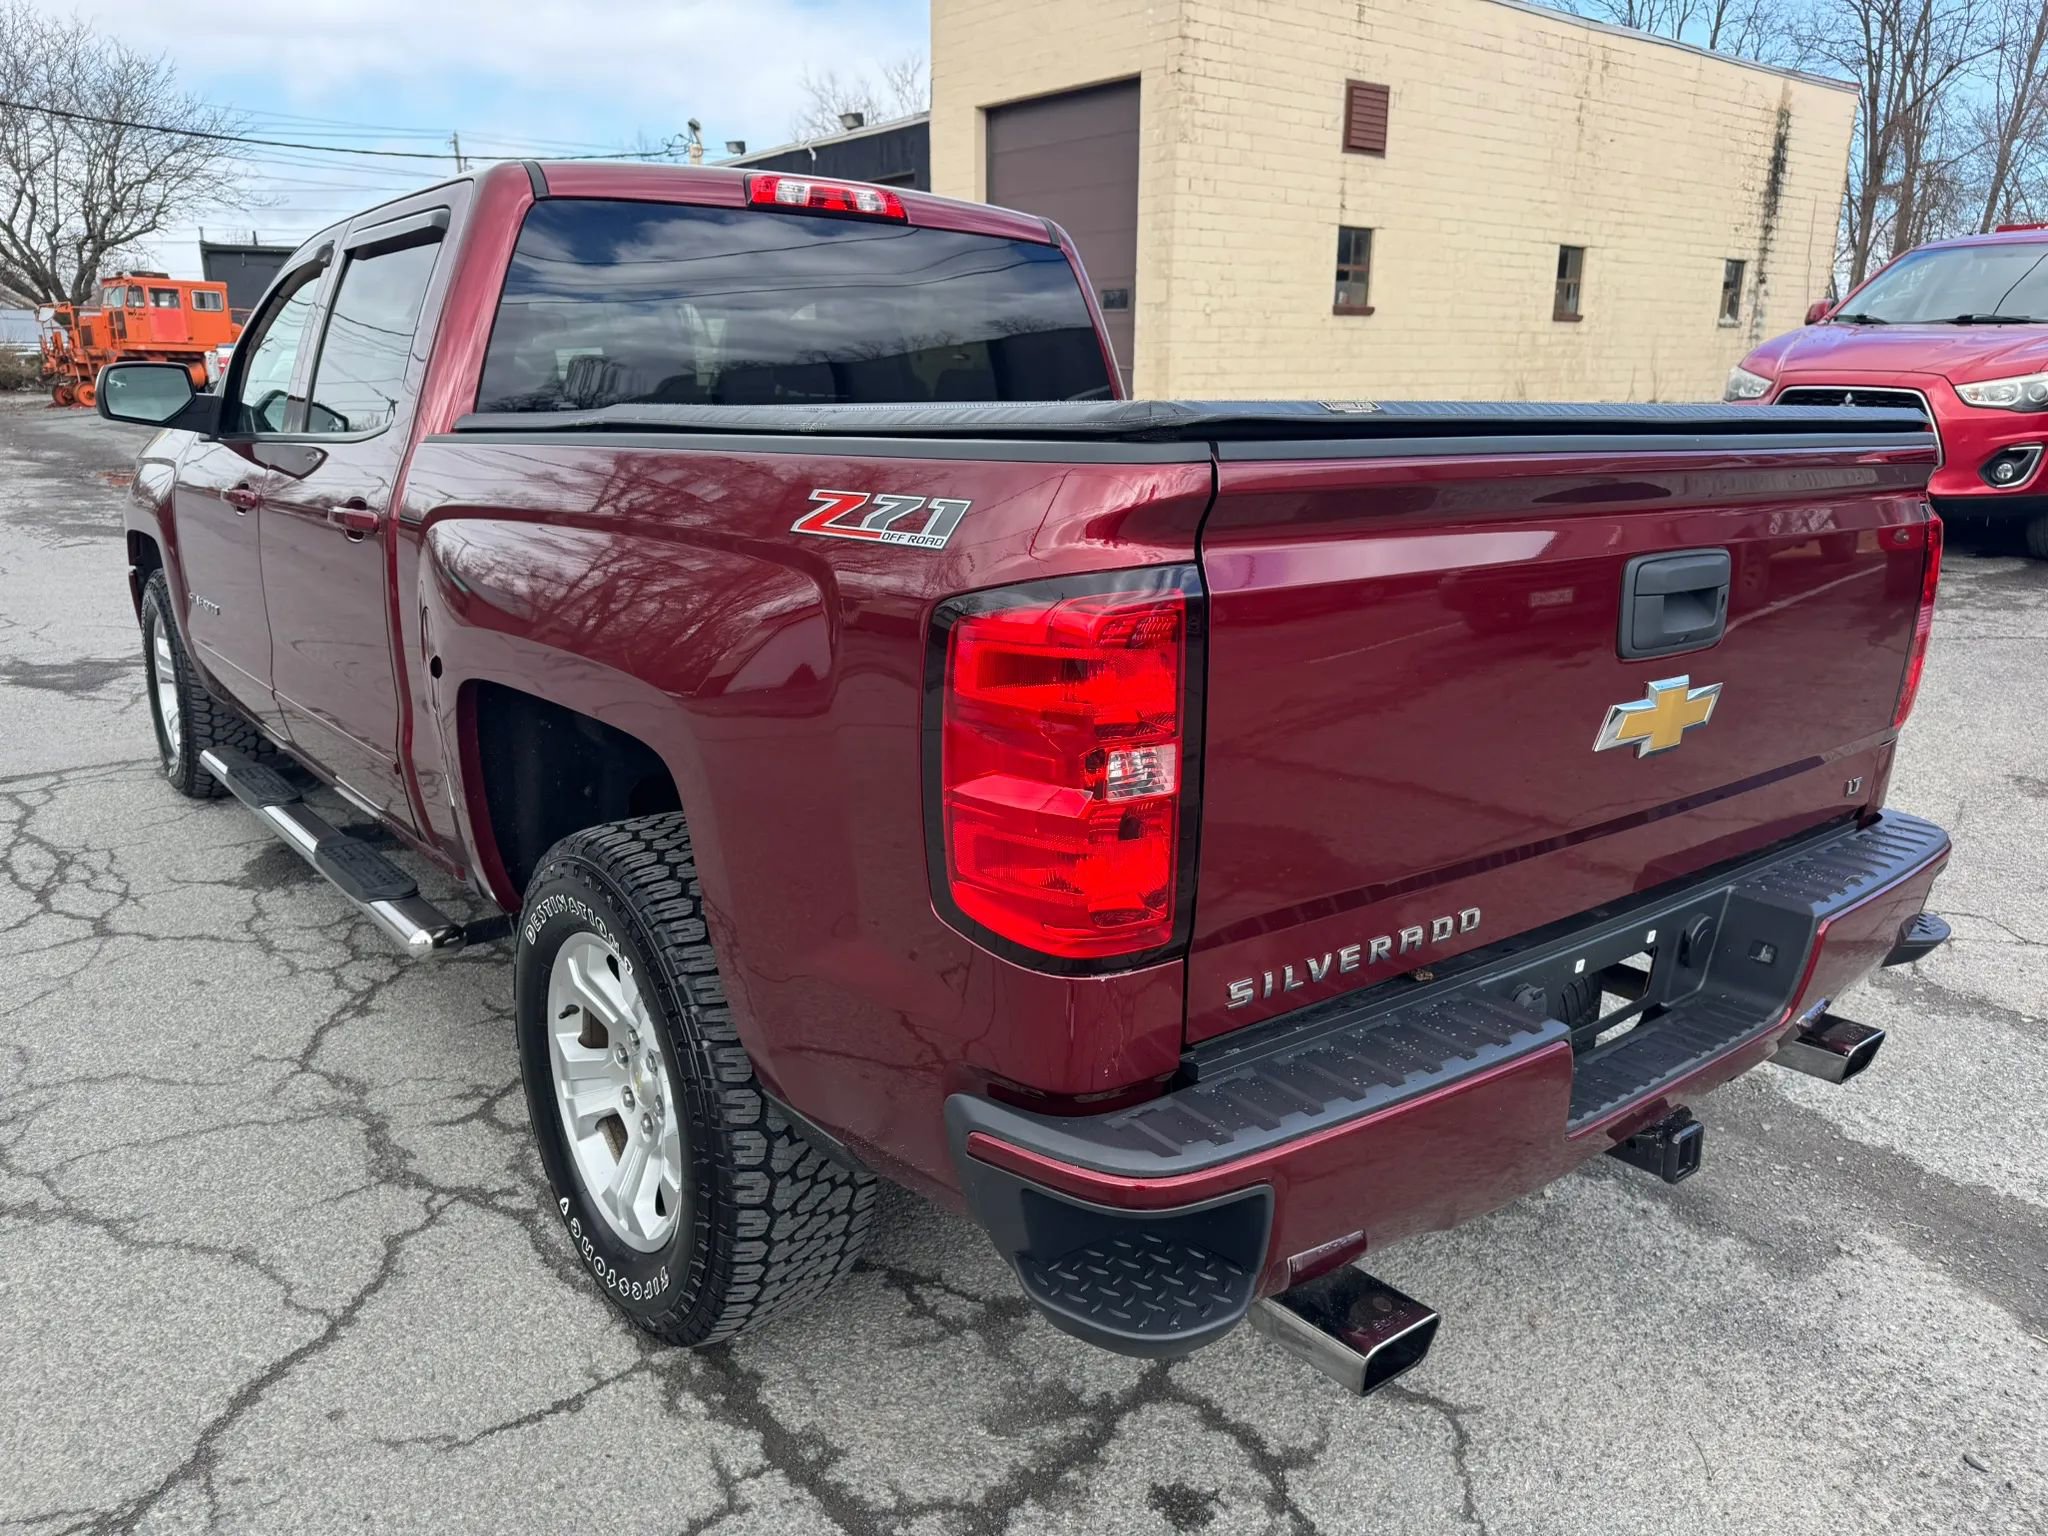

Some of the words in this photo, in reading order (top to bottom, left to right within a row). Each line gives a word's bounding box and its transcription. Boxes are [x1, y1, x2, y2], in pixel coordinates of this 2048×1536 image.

[790, 488, 972, 545] Z71
[881, 532, 907, 542] OFF
[907, 534, 945, 547] ROAD
[1225, 907, 1481, 1010] SILVERADO
